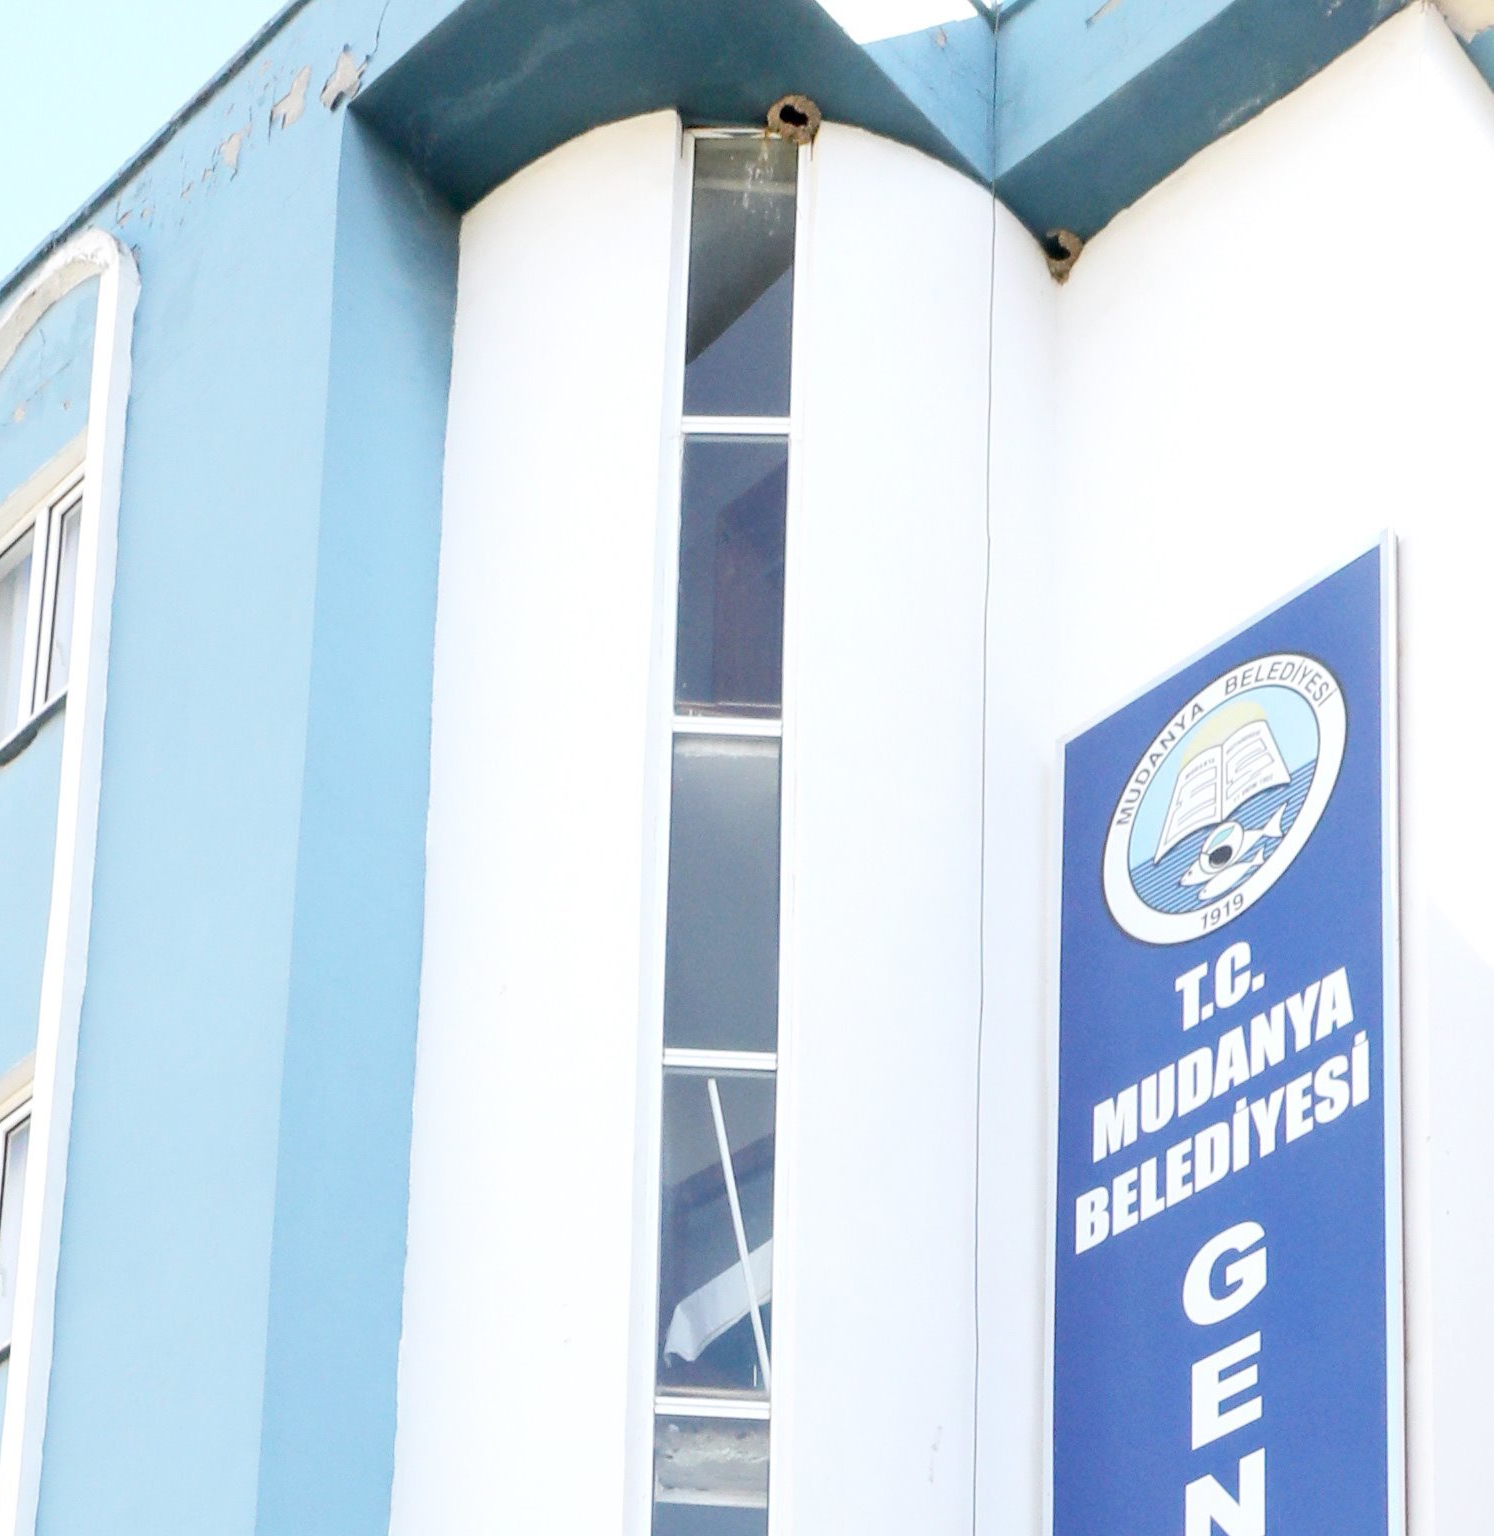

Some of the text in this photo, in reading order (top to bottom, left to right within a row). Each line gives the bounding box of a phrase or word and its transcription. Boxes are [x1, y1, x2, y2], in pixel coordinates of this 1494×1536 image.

[1115, 658, 1337, 827] MUDANYA BELEDİYESİ
[1174, 940, 1266, 1033] T.C.
[1199, 892, 1245, 931] 1919
[1074, 1029, 1371, 1256] BELEDİYESİ
[1092, 965, 1355, 1165] MUDANYA
